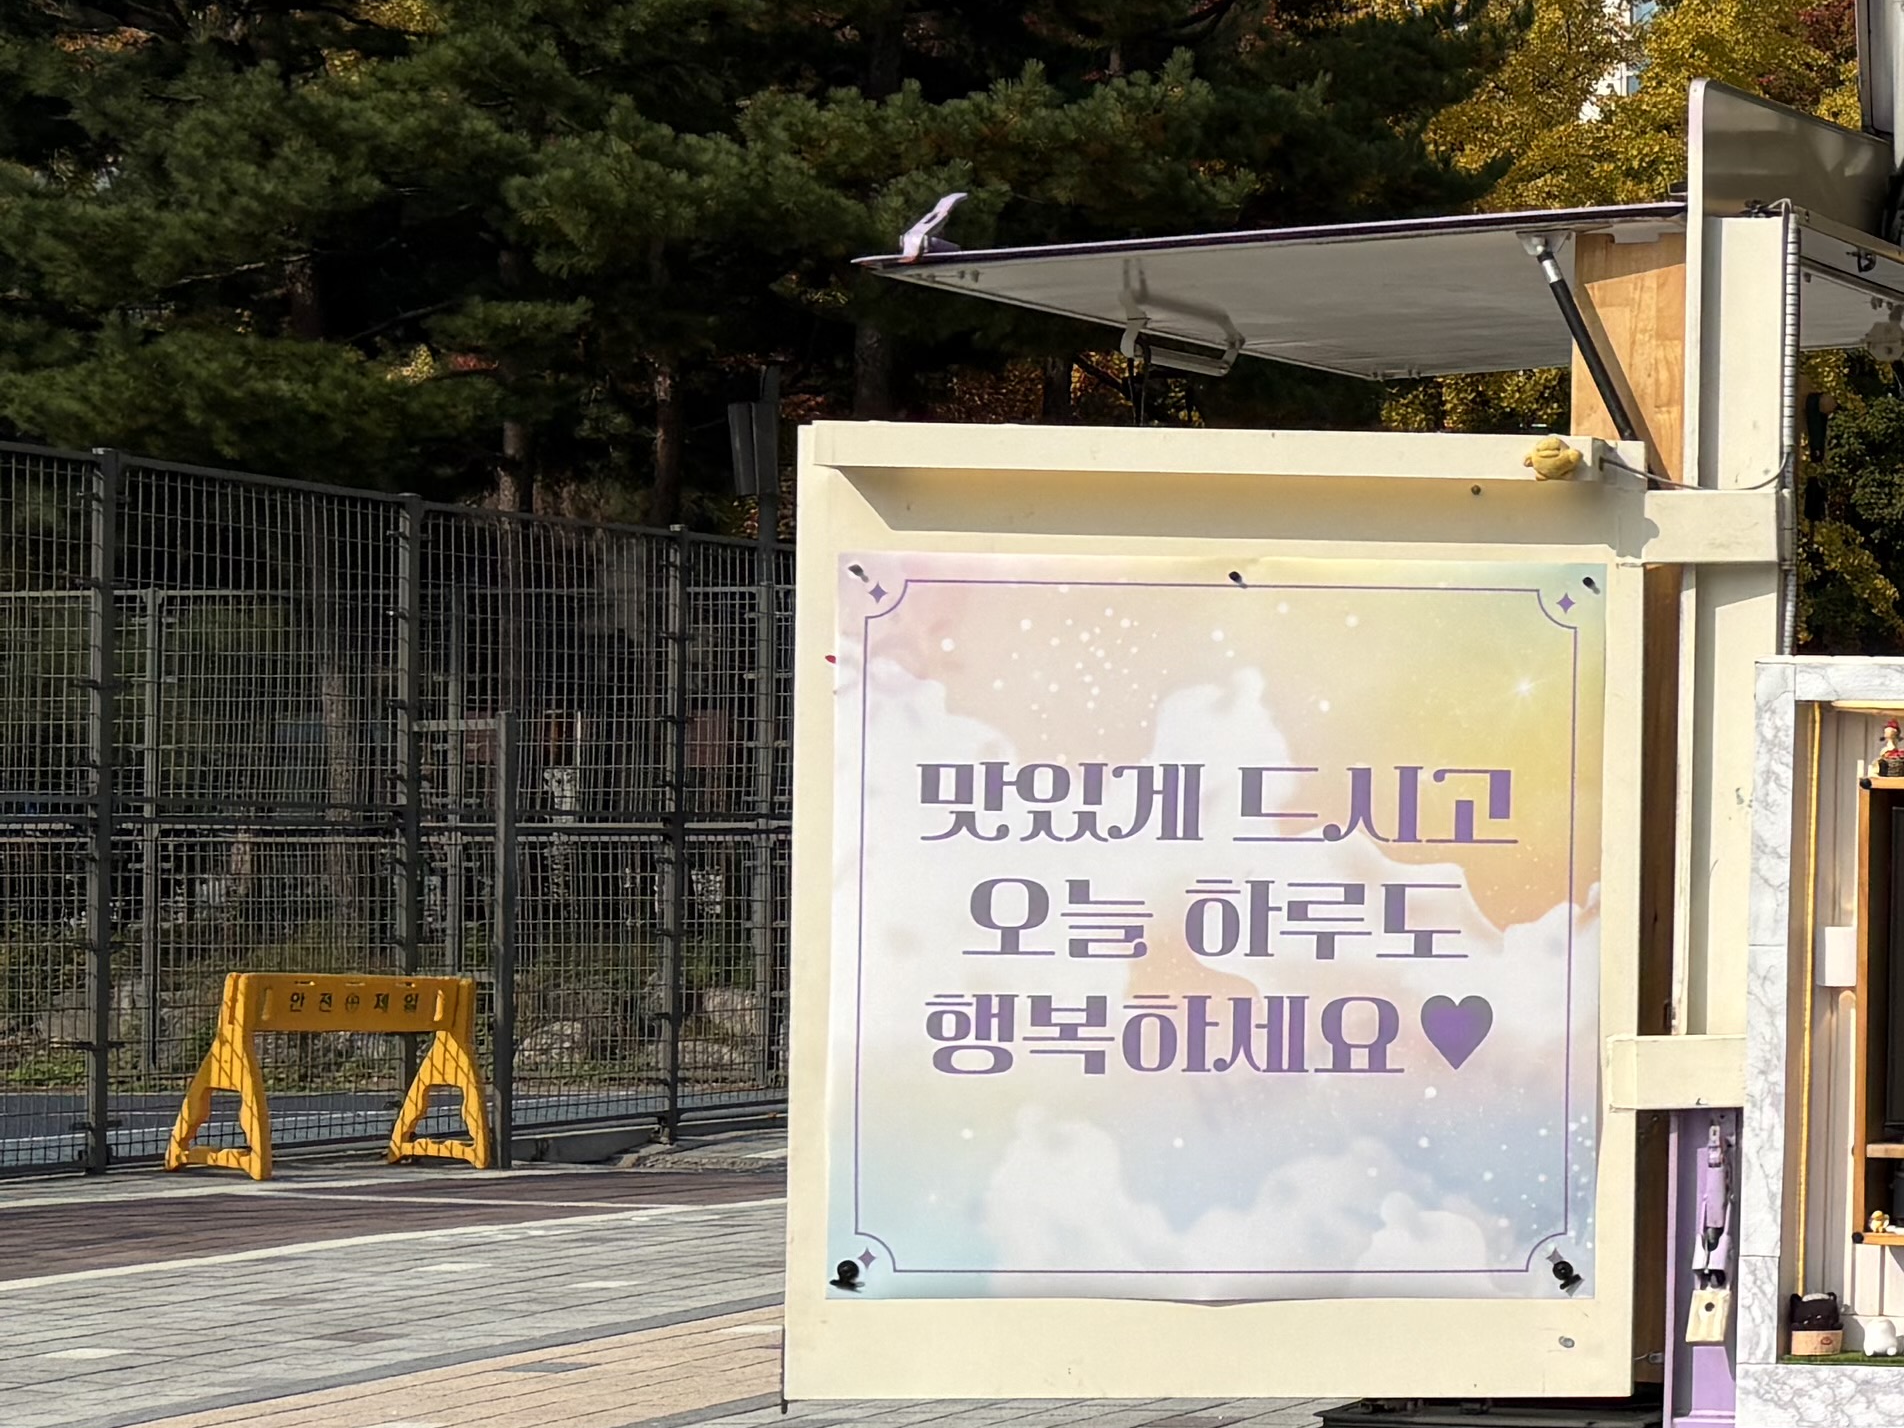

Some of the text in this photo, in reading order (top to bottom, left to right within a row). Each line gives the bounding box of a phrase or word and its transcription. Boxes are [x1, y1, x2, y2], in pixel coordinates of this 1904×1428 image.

[915, 760, 1520, 845] 맛있게 드시고
[961, 876, 1470, 961] 오늘 하루도
